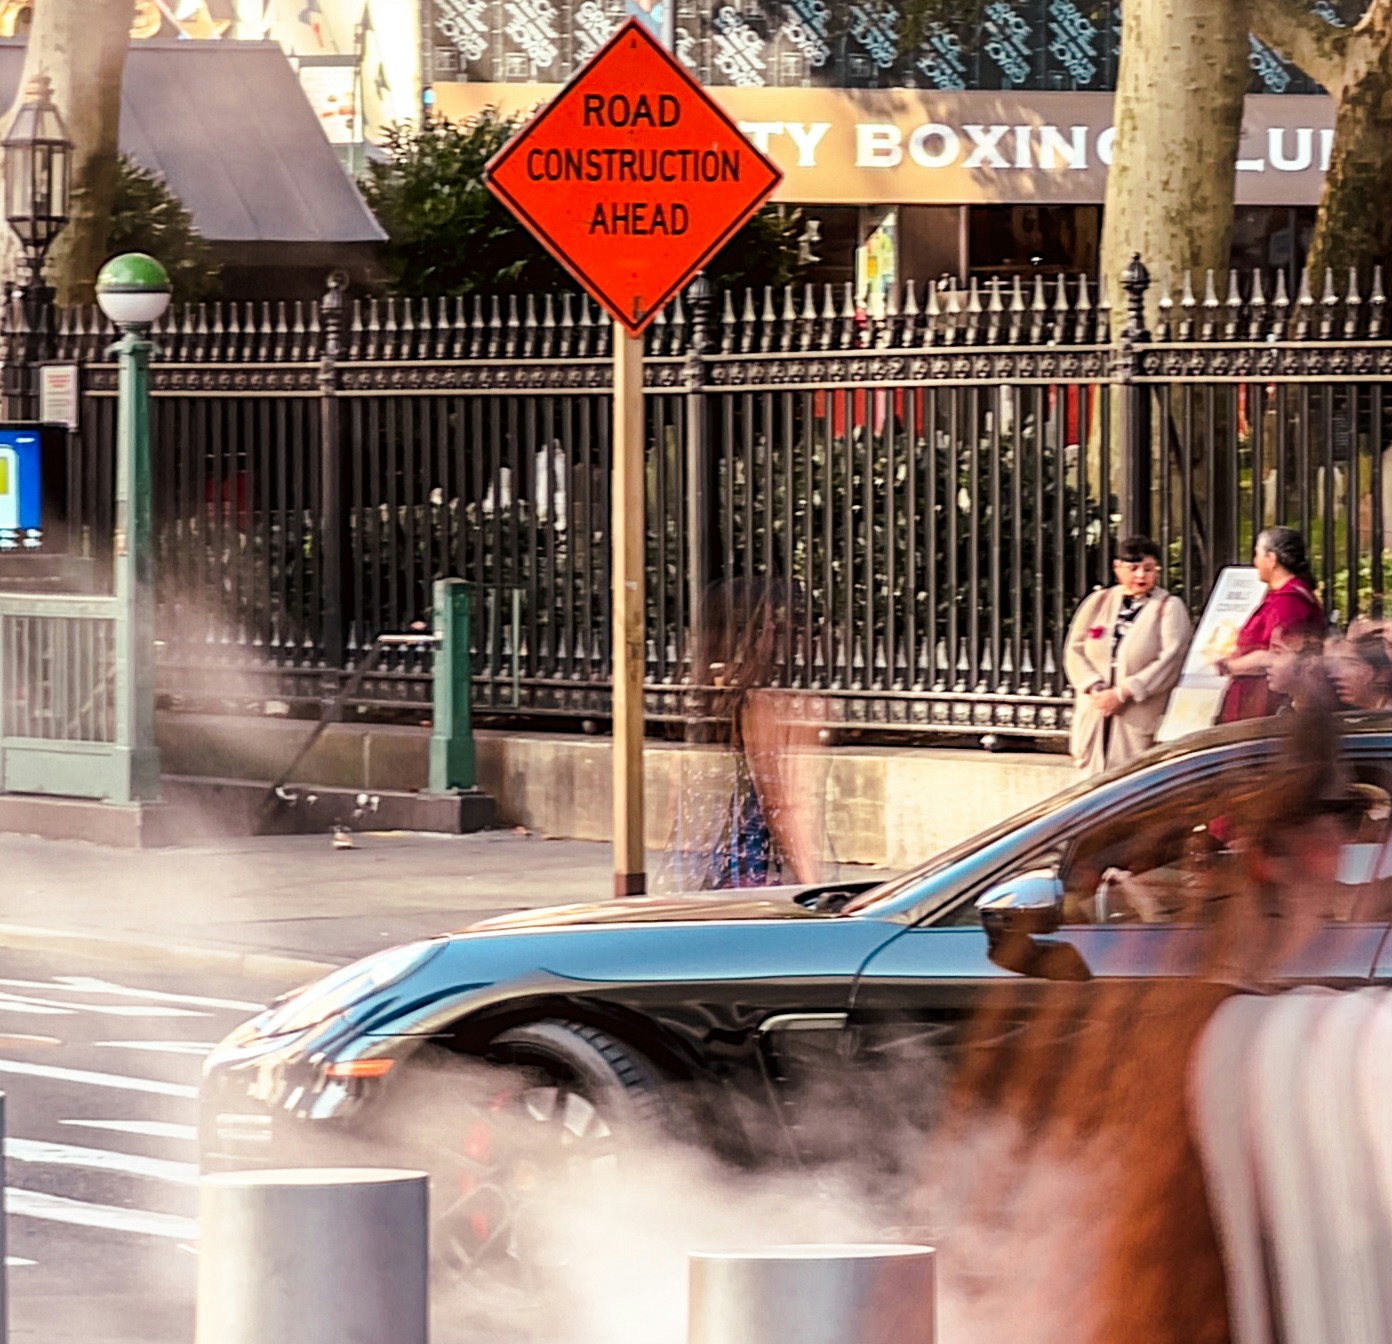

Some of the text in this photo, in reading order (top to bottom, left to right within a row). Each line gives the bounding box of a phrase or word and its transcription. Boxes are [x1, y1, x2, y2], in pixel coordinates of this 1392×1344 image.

[583, 94, 681, 128] ROAD
[527, 148, 740, 182] CONSTRUCTION
[589, 203, 689, 236] AHEAD
